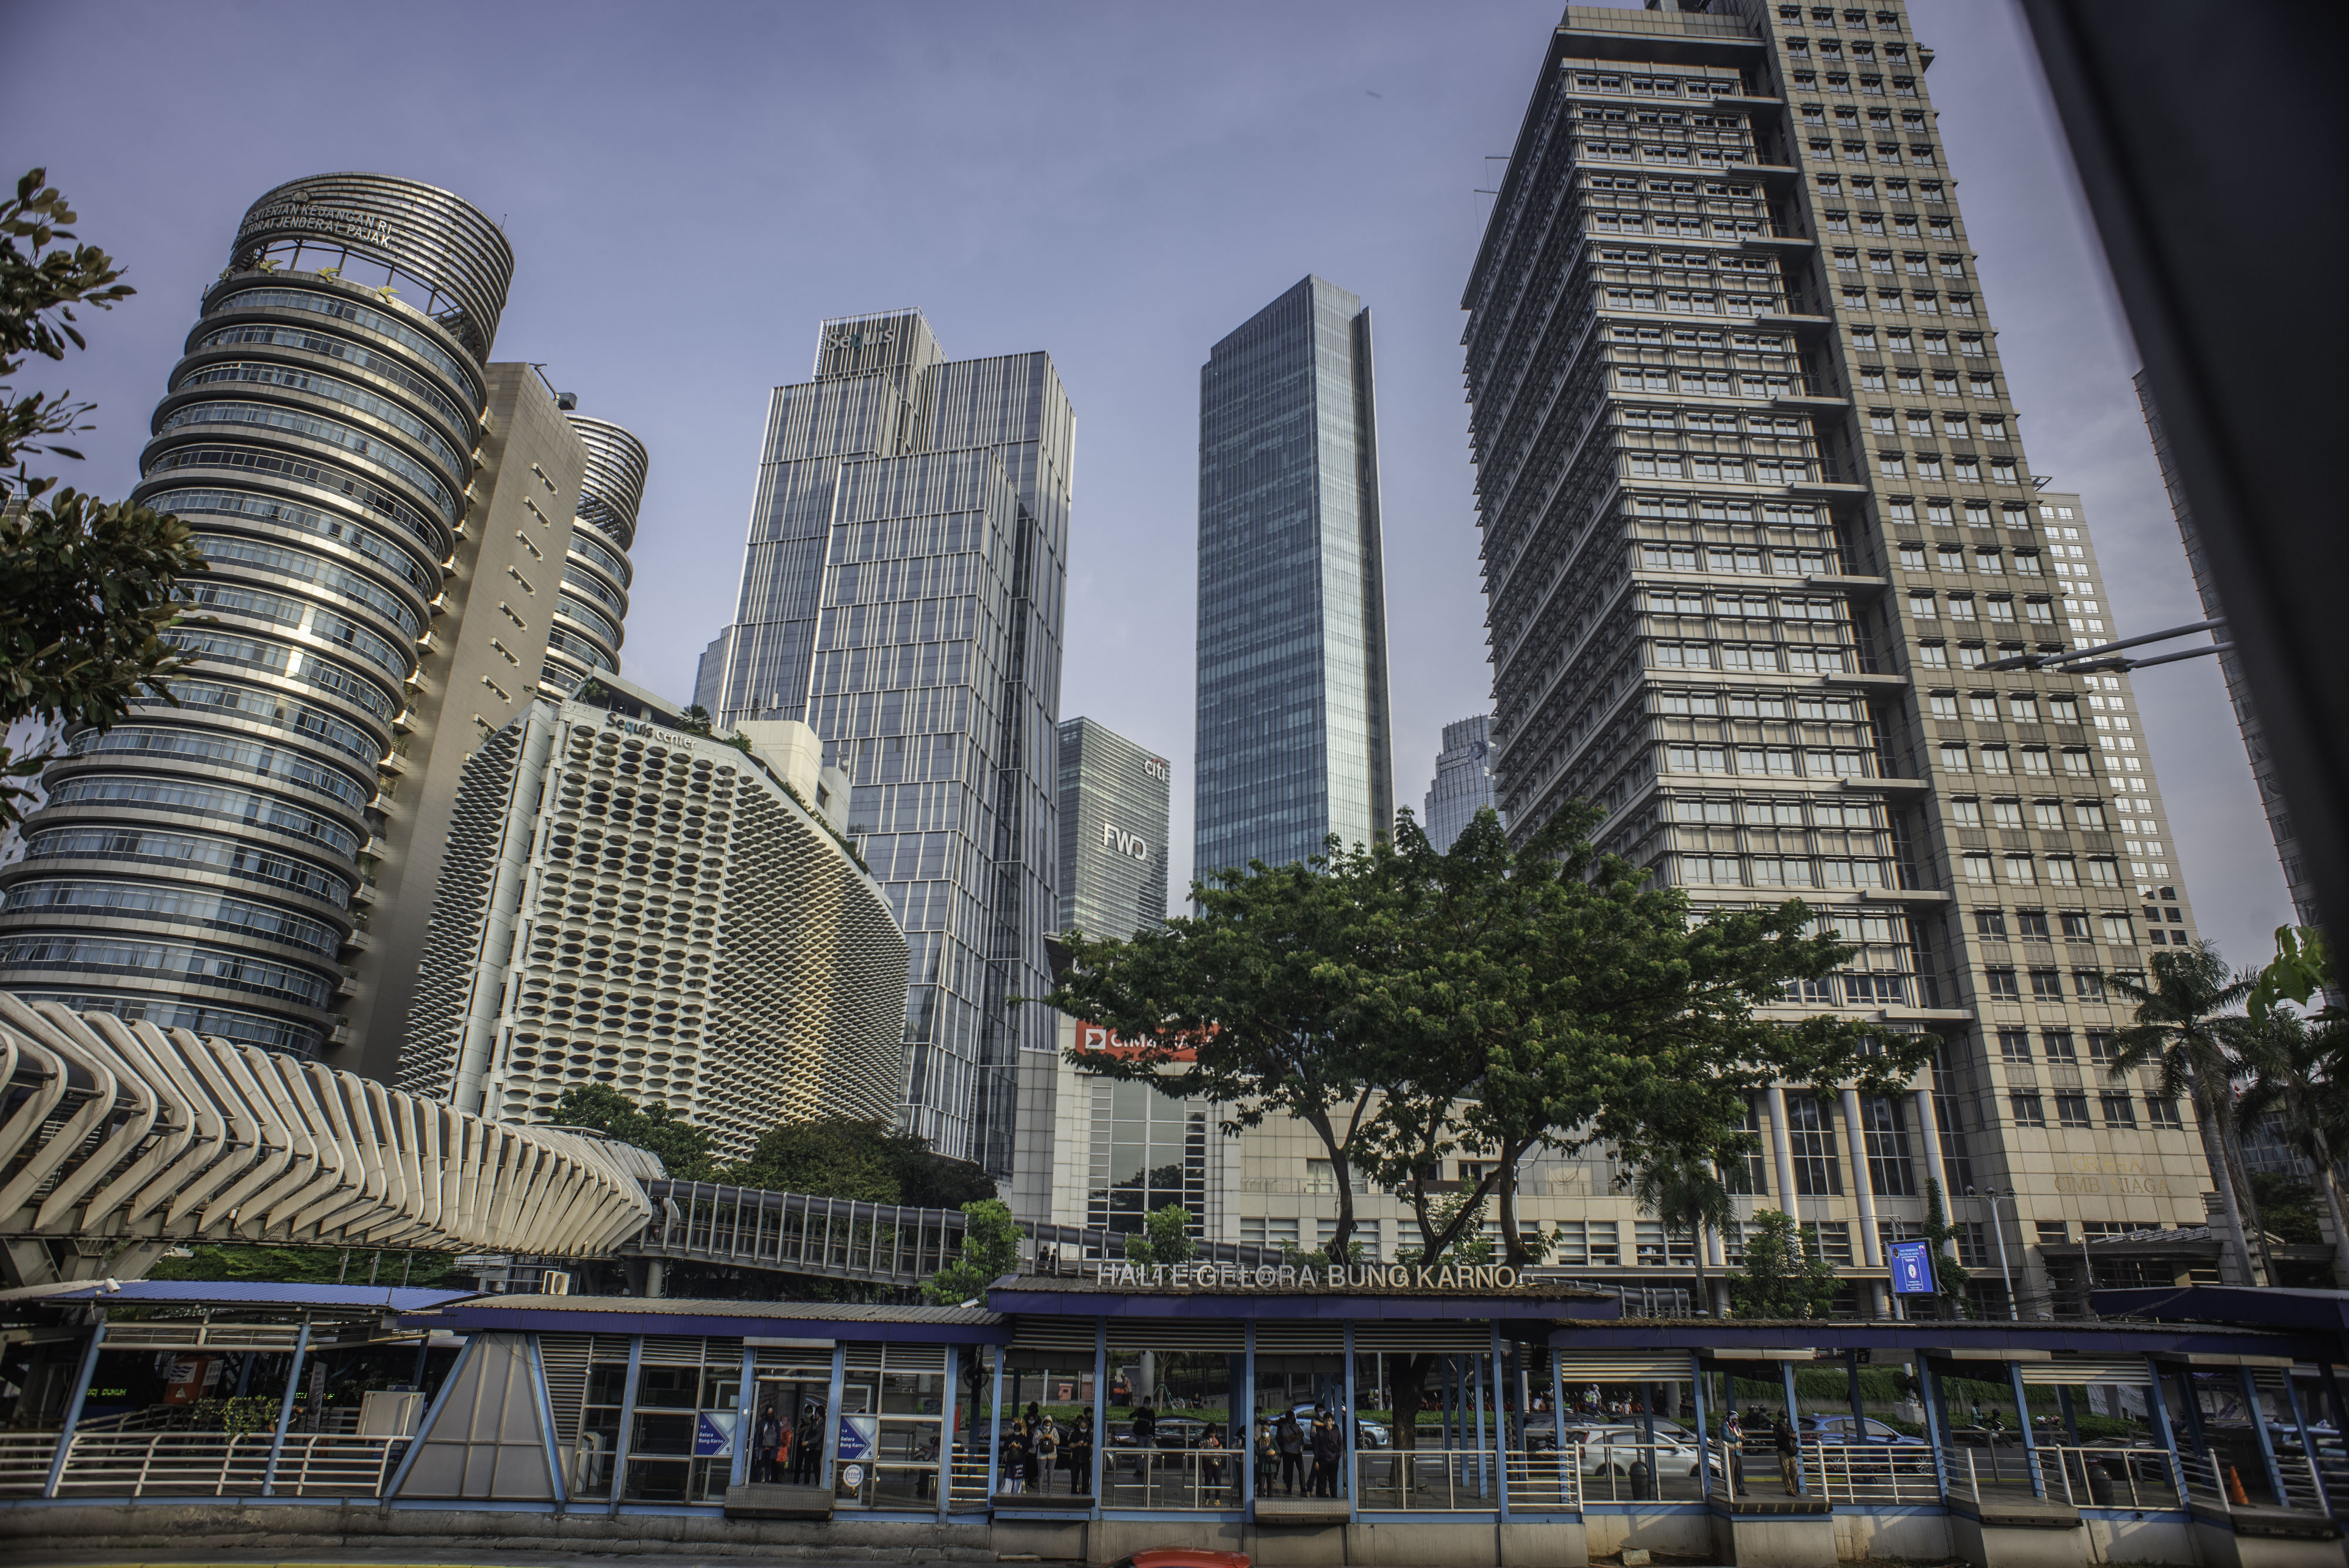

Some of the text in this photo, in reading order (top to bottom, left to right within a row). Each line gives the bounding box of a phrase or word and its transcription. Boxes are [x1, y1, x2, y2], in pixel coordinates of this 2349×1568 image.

[301, 204, 375, 228] KEUANGAN
[378, 220, 392, 234] RI
[277, 216, 342, 234] JENDERAL
[347, 224, 391, 248] PAJAK
[826, 327, 894, 352] Sequis
[606, 712, 697, 750] Sequis center
[1143, 759, 1166, 782] citi
[1103, 822, 1147, 861] FWD
[2072, 1156, 2143, 1173] GRAHA
[2054, 1176, 2172, 1194] CIMB NIAGA
[1098, 1263, 1516, 1288] HALTE GELORA BUNG KARNO
